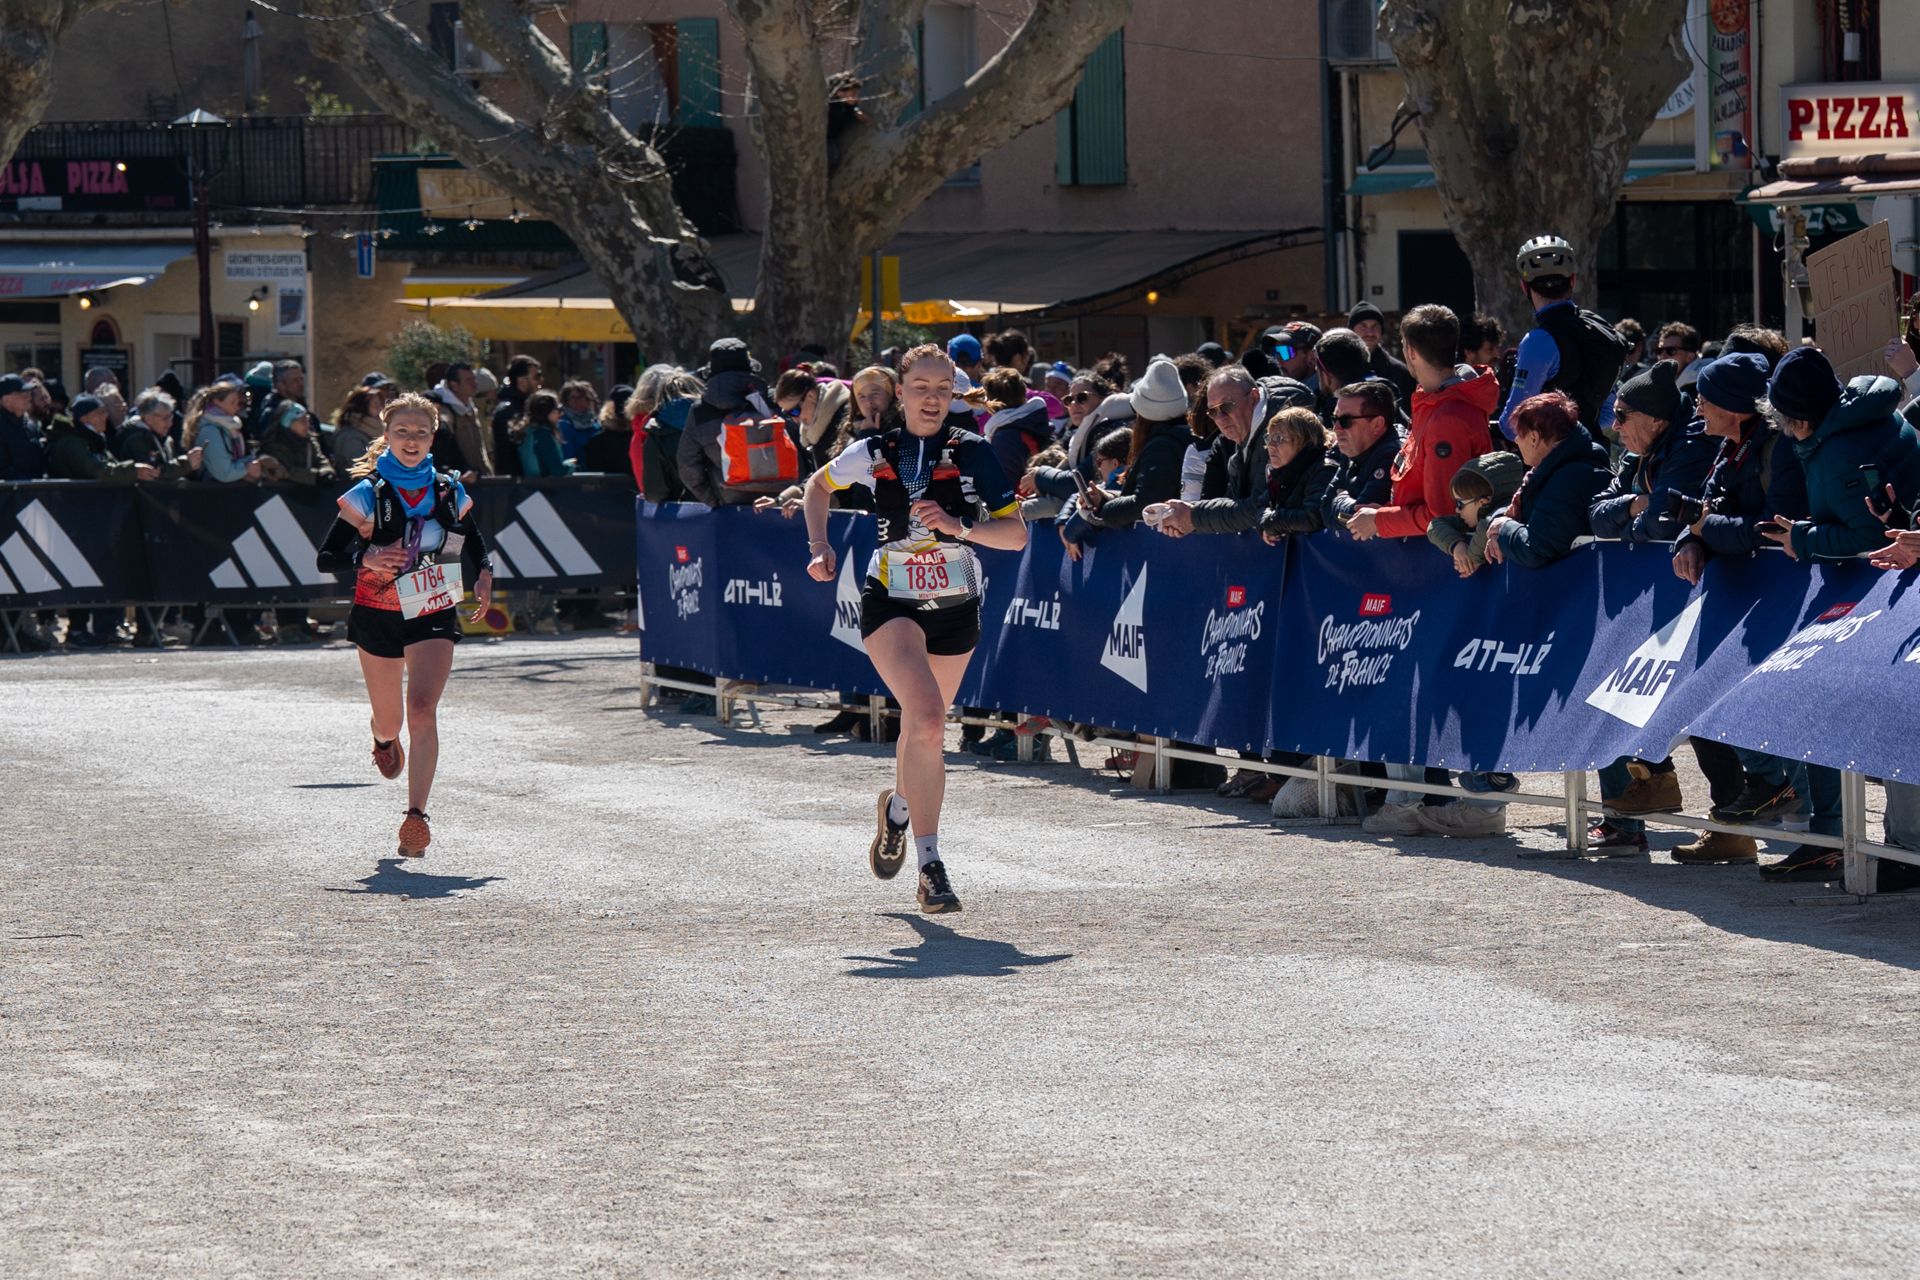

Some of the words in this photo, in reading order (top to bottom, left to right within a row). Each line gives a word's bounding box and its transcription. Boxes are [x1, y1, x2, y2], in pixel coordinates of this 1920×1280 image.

[1788, 96, 1909, 141] PIZZA
[67, 161, 129, 194] PIZZA
[1829, 297, 1871, 355] PAPY
[911, 551, 944, 565] MAIF
[411, 565, 445, 593] 1764
[906, 566, 950, 590] 1839
[425, 594, 451, 613] MAIF
[1229, 589, 1243, 605] MAIF
[1363, 597, 1386, 613] MAIF
[1109, 623, 1144, 660] MAIF
[1213, 641, 1247, 682] FRANCE
[1337, 649, 1394, 696] FRANCE
[1605, 656, 1677, 697] MAIF
